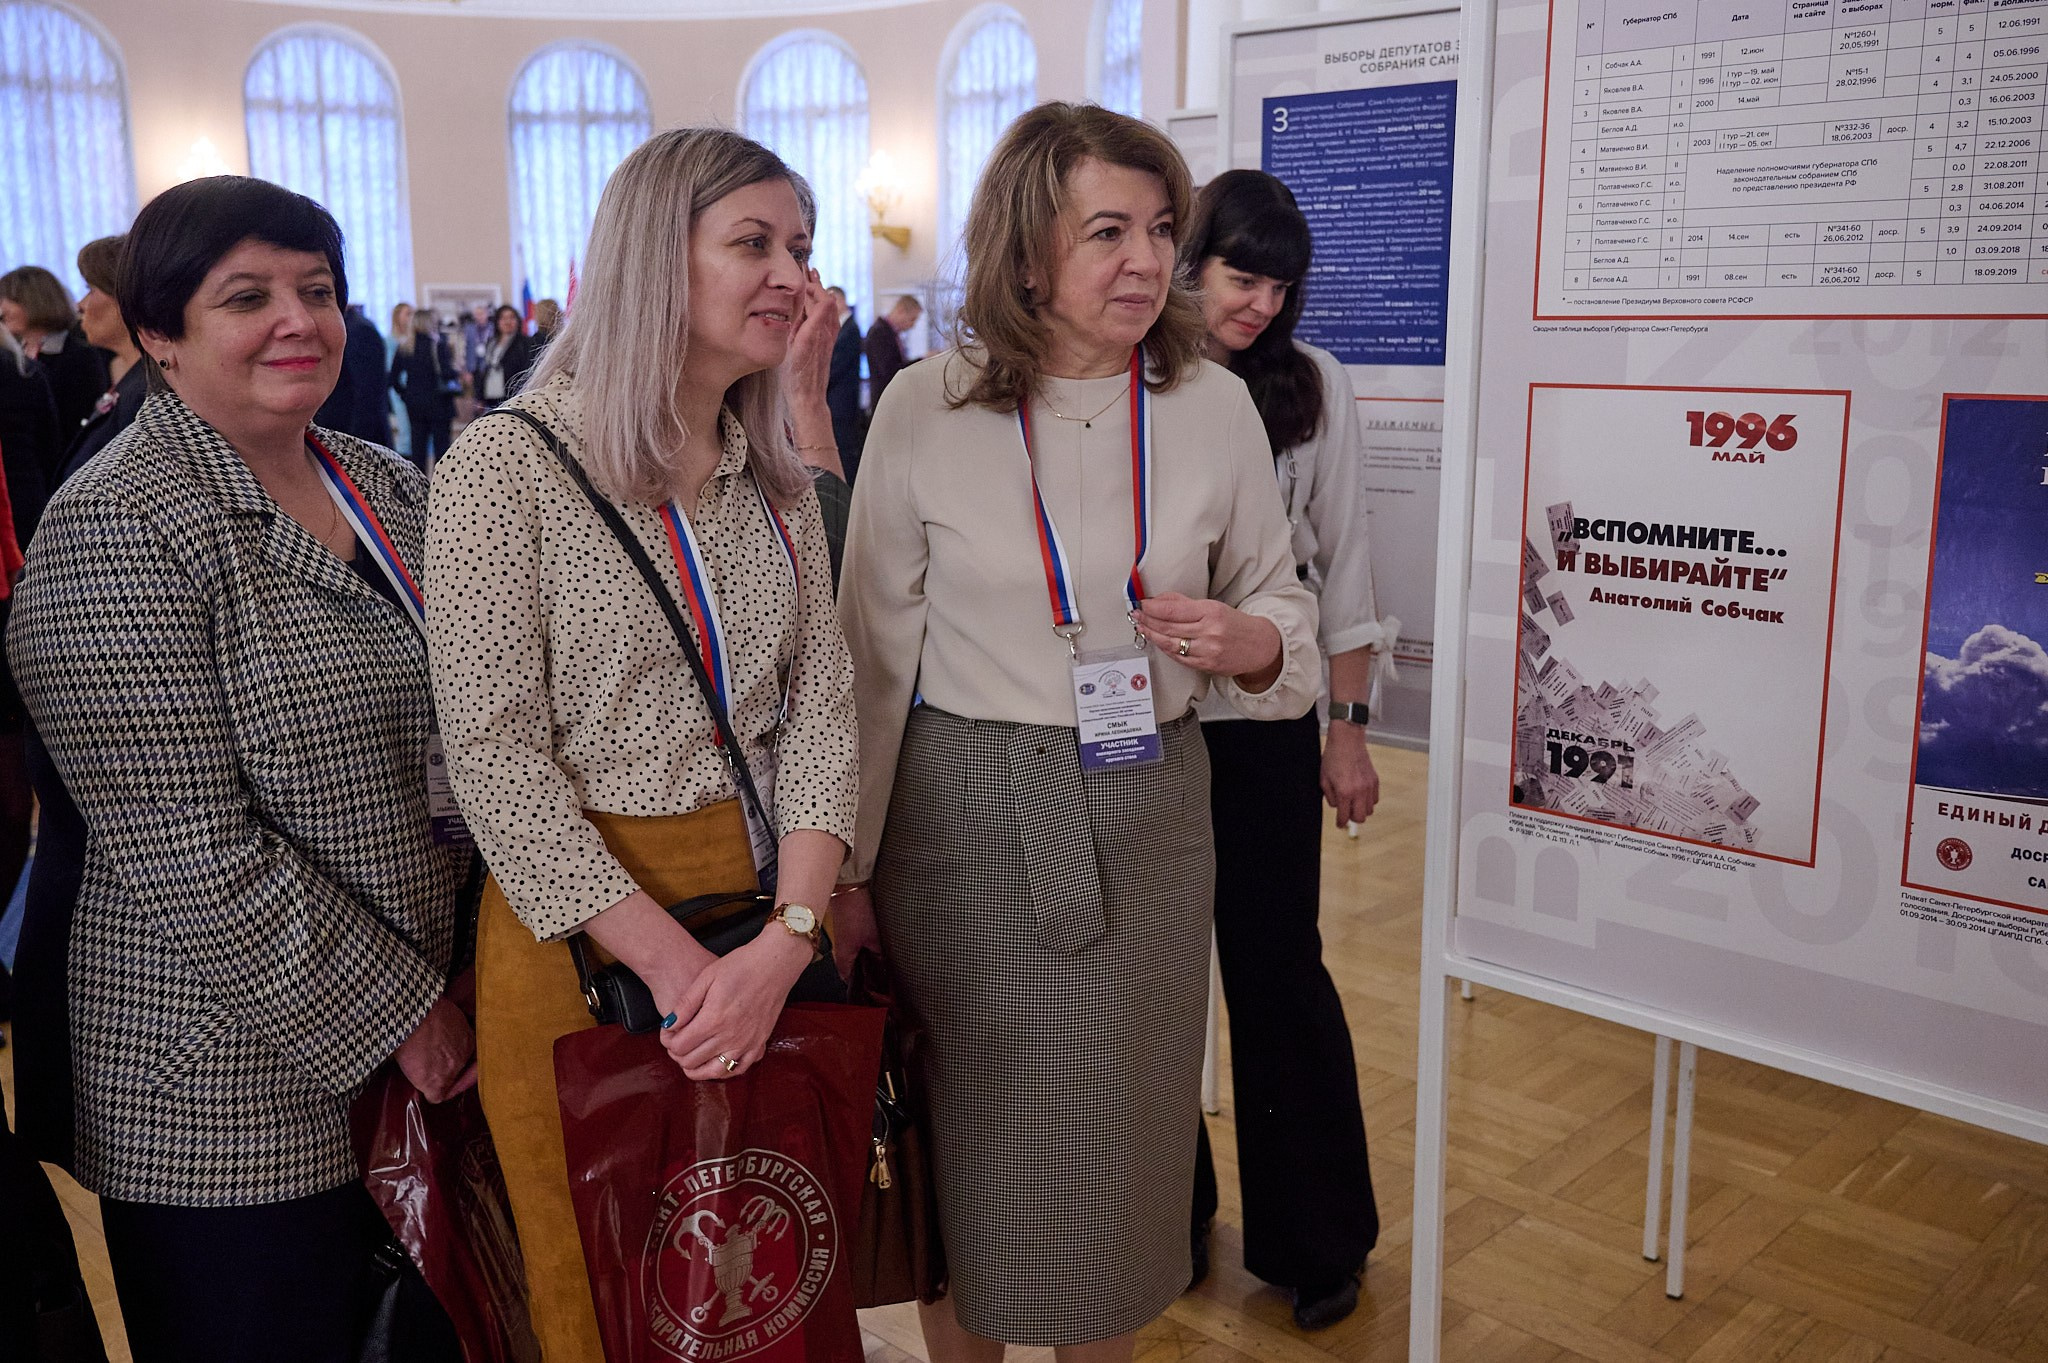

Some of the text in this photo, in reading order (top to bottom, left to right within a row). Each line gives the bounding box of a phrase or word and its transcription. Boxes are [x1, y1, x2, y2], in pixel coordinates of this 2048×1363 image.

[1792, 0, 1828, 10] Страница
[1848, 4, 1883, 12] выборах
[1623, 16, 1661, 26] Губернатор
[1998, 18, 2040, 28] 12.06.1991
[1324, 41, 1451, 64] ВЫБОРЫ ДЕПУТАТОВ
[1993, 46, 2040, 58] 05.06.1996
[1360, 54, 1459, 74] СОБРАНИЯ САН
[1990, 72, 2038, 82] 24.05.2000
[1989, 93, 2035, 103] 16.06.2003
[1696, 100, 1714, 108] 2000
[1988, 116, 2032, 126] 15.10.2003
[1693, 139, 1710, 147] 2003
[1984, 139, 2030, 149] 22.12.2006
[1812, 161, 1859, 170] губернатора
[1984, 160, 2027, 169] 22.08.2011
[1734, 174, 1797, 183] законодательным
[1742, 184, 1798, 192] представлению
[1984, 181, 2024, 190] 31.08.2011
[1979, 202, 2024, 210] 04.06.2014
[1978, 224, 2022, 232] 24.09.2014
[1975, 246, 2020, 254] 03.09.2018
[1651, 326, 1708, 334] Санкт-Петербурга
[1686, 411, 1798, 452] 1996
[1712, 451, 1765, 464] МАЙ
[1557, 550, 1576, 572] И
[1589, 587, 1784, 624] Анатолий Собчак
[1107, 720, 1128, 729] СМЫК
[1100, 738, 1139, 750] УЧАСТНИК
[1546, 728, 1635, 752] ДЕКАБРЬ
[1546, 741, 1634, 789] 1991
[1938, 802, 2031, 831] ЕДИНЫЙ
[1509, 811, 1528, 821] Плакат
[1533, 817, 1564, 829] поддержку
[1565, 824, 1595, 834] кандидата
[1617, 834, 1656, 847] Губернатора
[1657, 842, 1713, 859] Санкт-Петербурга
[1901, 892, 2048, 928] Плакат Санкт-Петербургской избирате
[1900, 902, 2048, 938] голосования. Досрочные выборы Губе
[1900, 910, 1938, 923] 01.09.2014
[1945, 919, 1986, 933] 30.09.2014
[763, 1248, 830, 1338] КОМИССИЯ
